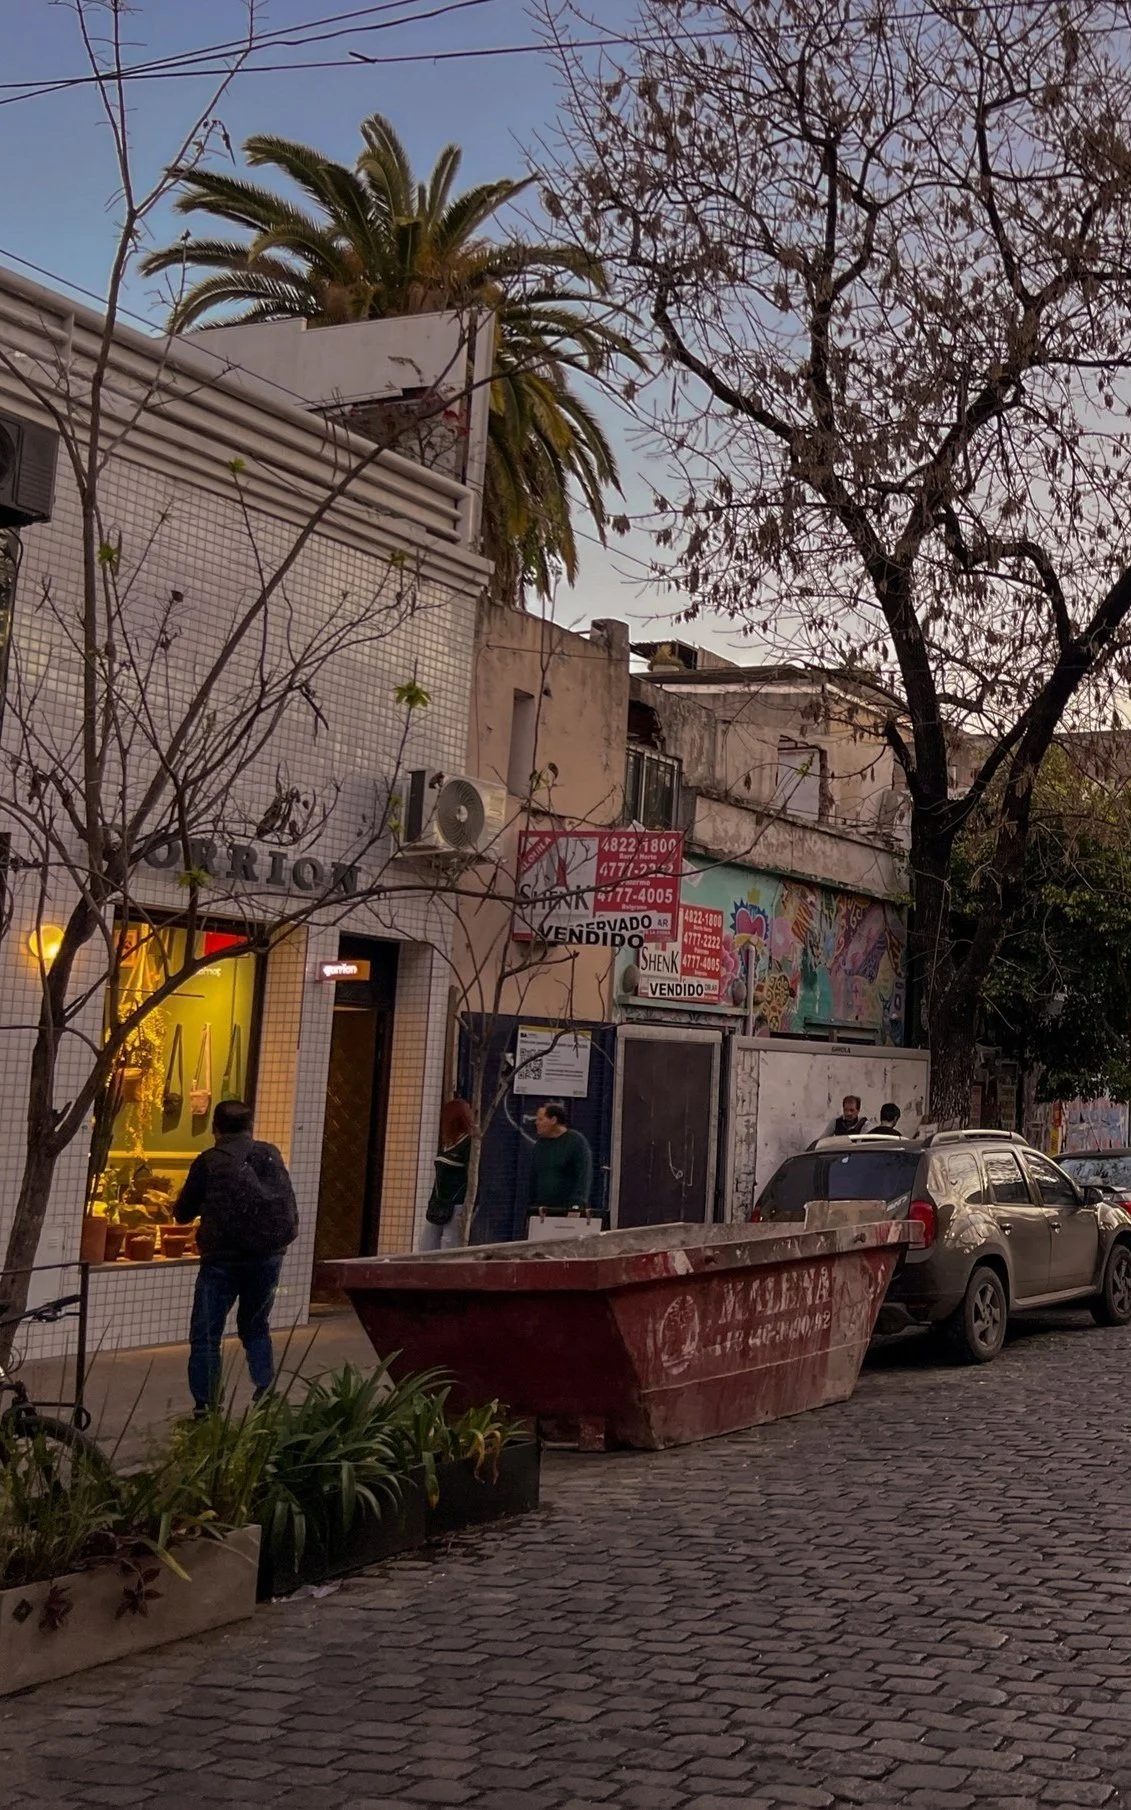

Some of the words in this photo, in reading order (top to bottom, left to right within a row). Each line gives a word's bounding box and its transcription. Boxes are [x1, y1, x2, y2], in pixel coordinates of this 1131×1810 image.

[103, 823, 361, 895] ORRION
[540, 924, 645, 949] VENDIDO
[641, 946, 679, 974] SHENK
[649, 983, 704, 997] VENDIDO
